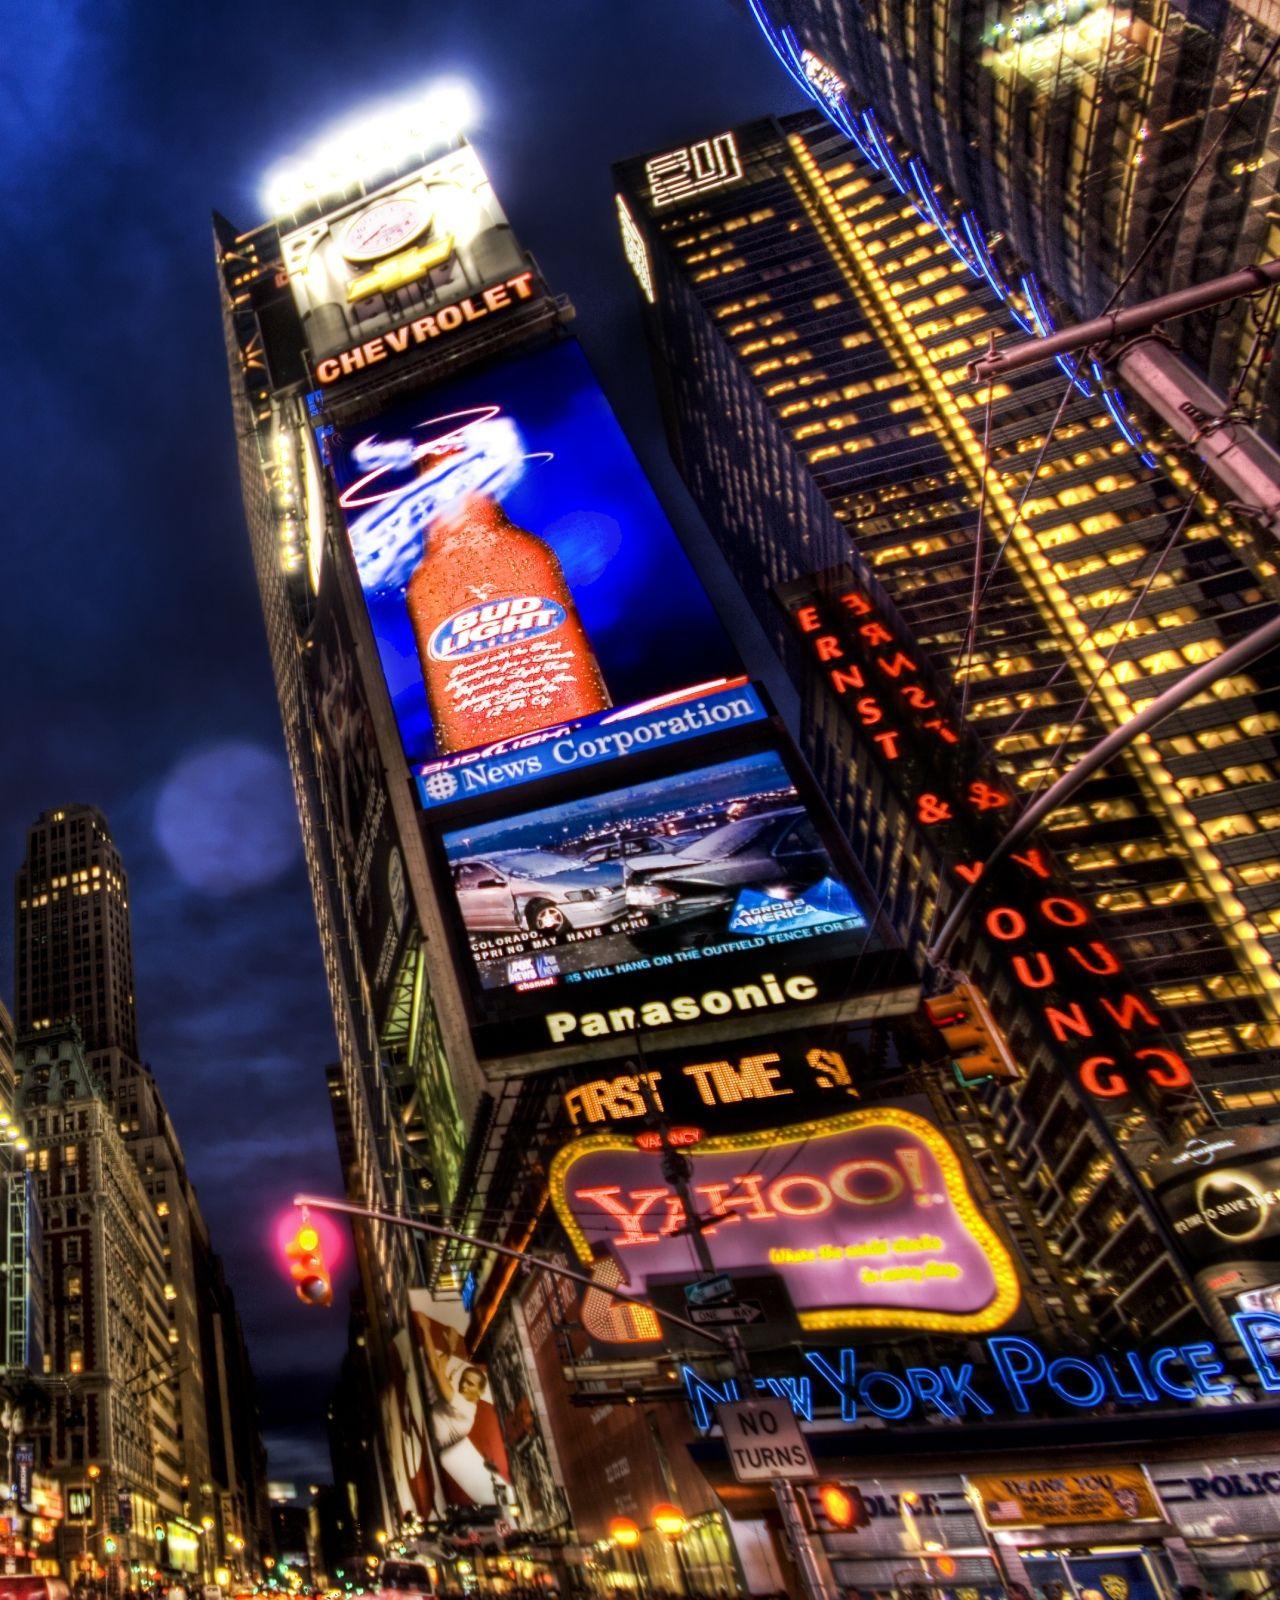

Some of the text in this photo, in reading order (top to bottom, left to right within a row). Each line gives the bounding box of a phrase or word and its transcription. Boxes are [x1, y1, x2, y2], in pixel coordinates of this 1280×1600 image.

[316, 272, 533, 384] CHEVROLET
[441, 610, 556, 658] LIGHT
[452, 597, 543, 635] BUD
[797, 606, 899, 759] ERNST
[917, 793, 953, 825] &
[464, 755, 543, 791] News
[552, 694, 754, 768] Corporation
[732, 904, 818, 928] AMERICA
[738, 899, 805, 917] ACROSS
[471, 931, 543, 951] COLORADO.
[532, 936, 557, 950] MAY
[566, 927, 603, 942] HAVE
[583, 966, 614, 980] WILL
[616, 958, 651, 974] HANG
[653, 953, 673, 966] ON
[675, 947, 701, 962] THE
[703, 937, 765, 957] OUTFIELD
[768, 928, 813, 944] FENCE
[815, 922, 843, 935] FOR
[518, 979, 555, 991] channel
[545, 973, 819, 1042] Panasonic
[565, 1071, 664, 1125] FIRST
[682, 1053, 794, 1106] TIME
[576, 1147, 932, 1246] YAHOO!
[1216, 1198, 1250, 1217] SAVE
[807, 1349, 994, 1421] YORK
[988, 1337, 1233, 1412] POLICE
[737, 1410, 778, 1436] NO
[734, 1446, 807, 1469] TURNS
[1002, 1474, 1114, 1495] THANK YOU
